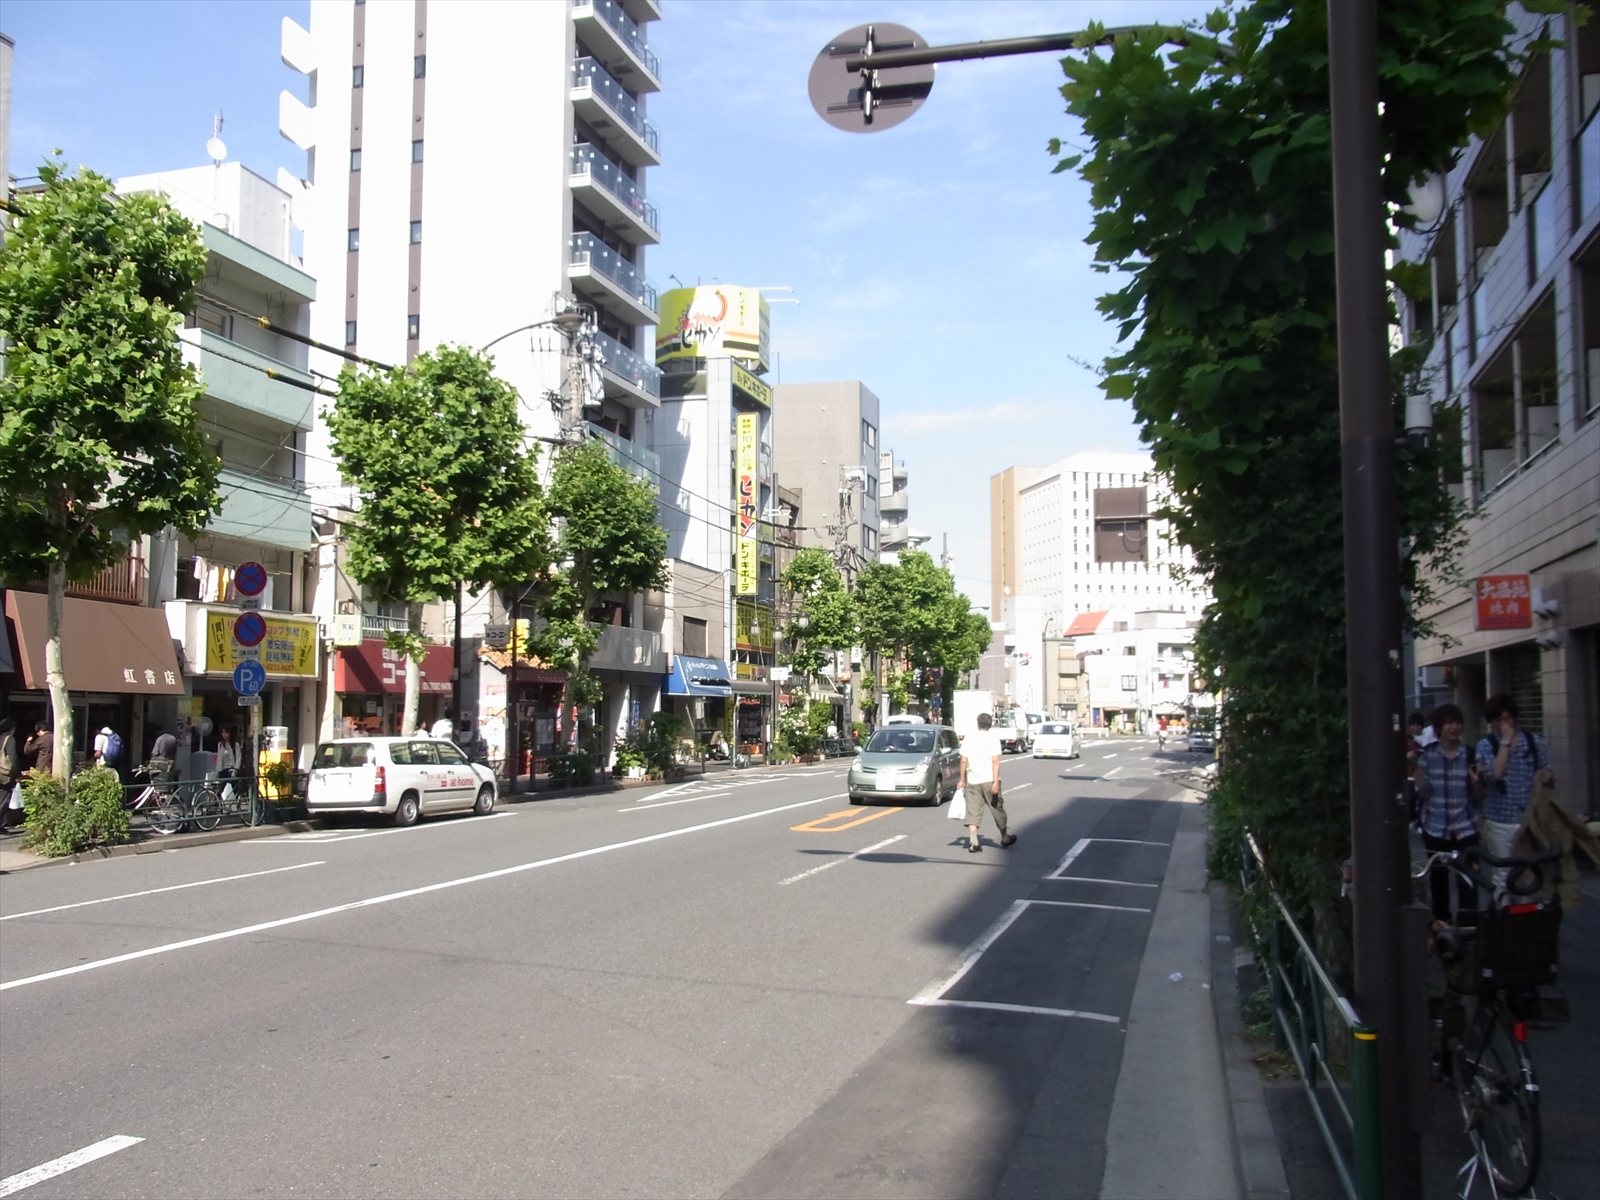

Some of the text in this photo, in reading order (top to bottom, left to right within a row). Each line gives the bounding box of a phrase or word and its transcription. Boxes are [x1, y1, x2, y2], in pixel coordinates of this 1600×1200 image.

[681, 320, 721, 349] ピカソ
[740, 473, 756, 538] ピカソ
[123, 667, 176, 685] 虹書店
[240, 669, 254, 691] P
[383, 663, 426, 684] コーー
[248, 681, 259, 691] 60
[450, 779, 457, 787] at
[457, 776, 474, 786] home
